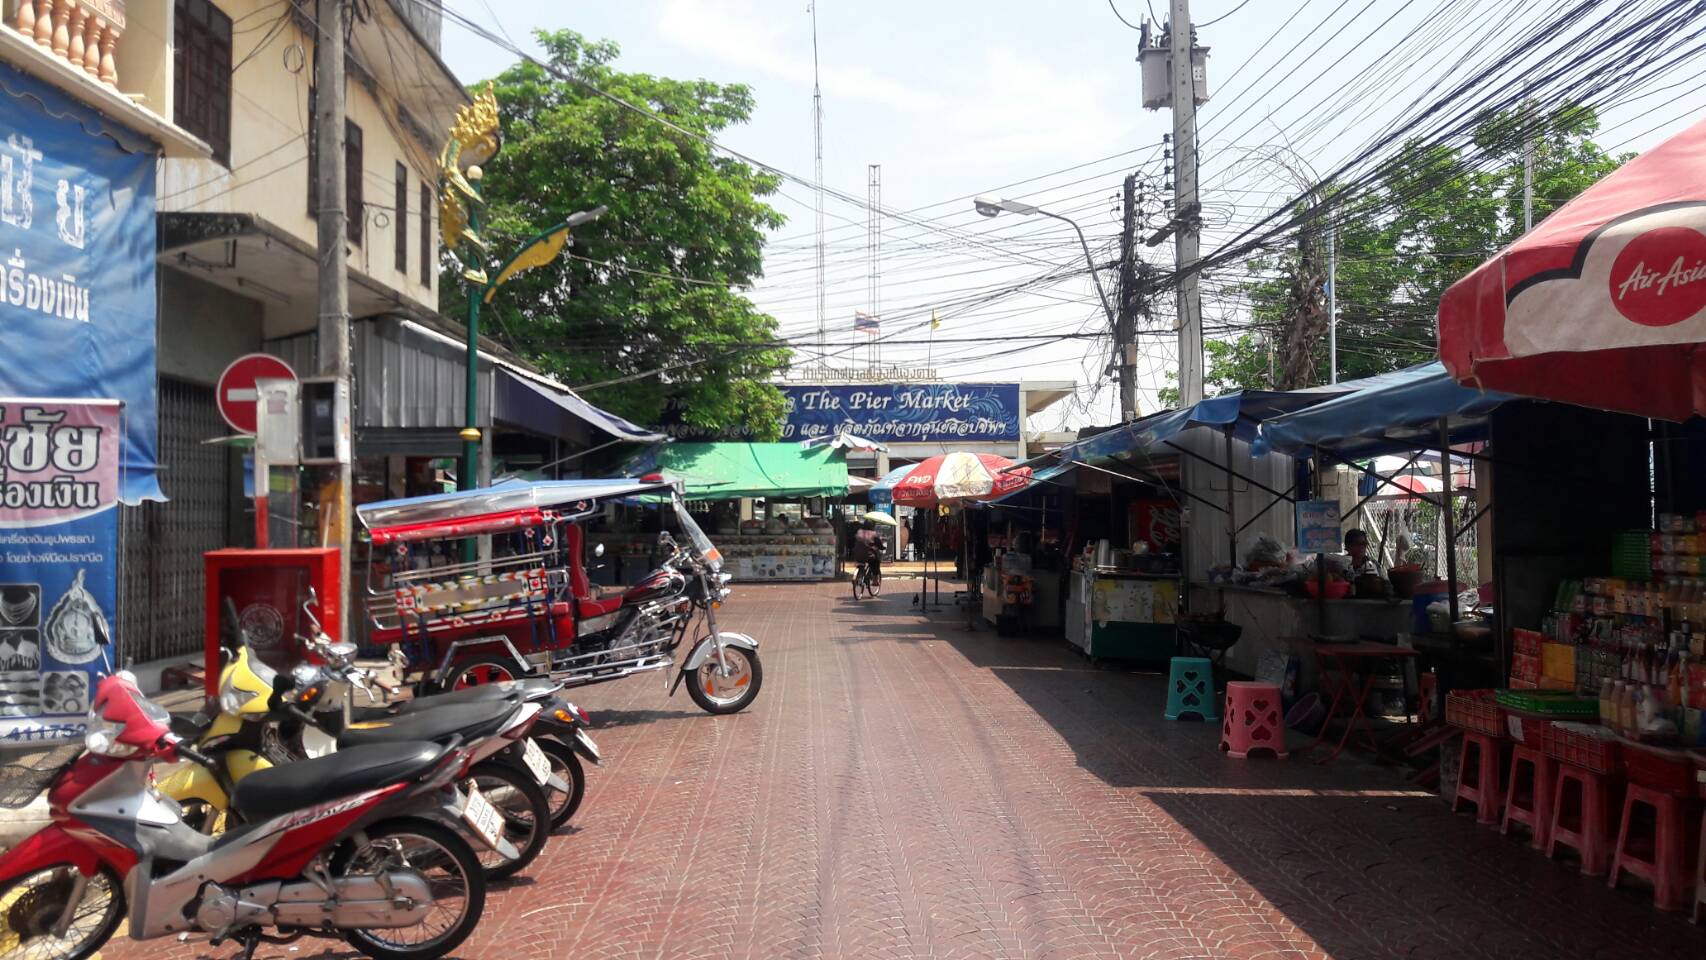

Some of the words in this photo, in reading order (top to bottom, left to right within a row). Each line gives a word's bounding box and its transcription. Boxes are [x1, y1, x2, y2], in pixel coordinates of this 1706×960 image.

[802, 391, 841, 410] The
[849, 392, 892, 411] Pier
[900, 391, 971, 412] Market
[0, 407, 103, 473] ชัย
[800, 424, 827, 437] และ
